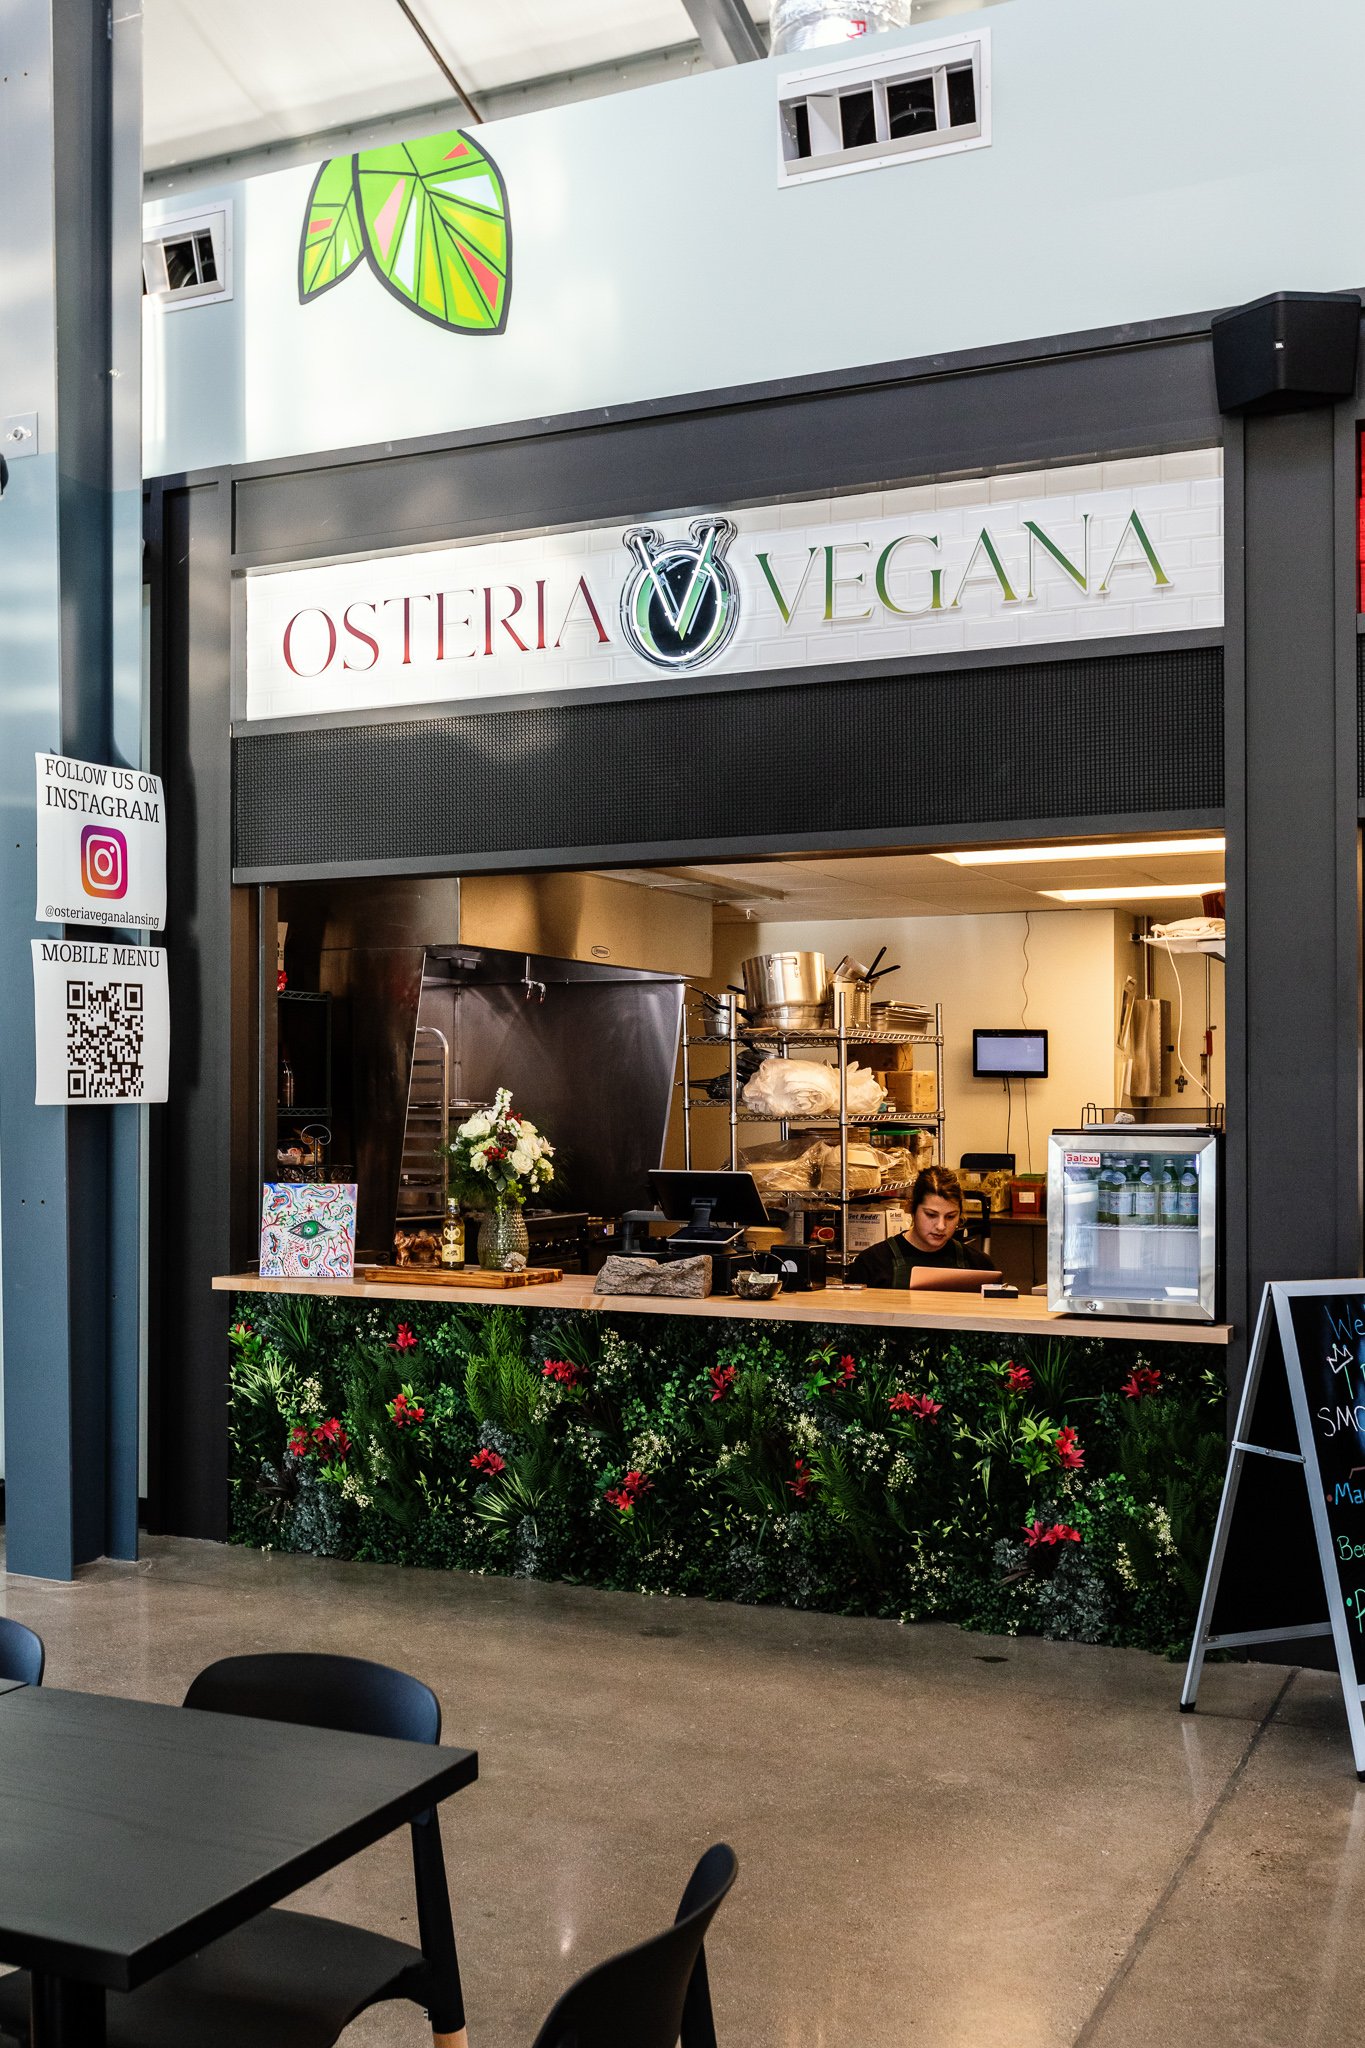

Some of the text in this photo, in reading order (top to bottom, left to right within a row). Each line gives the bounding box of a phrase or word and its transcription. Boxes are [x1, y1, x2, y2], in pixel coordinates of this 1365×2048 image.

[754, 508, 1175, 628] VEGANA
[281, 574, 611, 678] OSTERIA
[45, 758, 158, 795] FOLLOW US ON
[45, 784, 160, 824] INSTAGRAM
[45, 904, 160, 930] @osteriaveganalansing
[41, 943, 160, 968] MOBILE MENU
